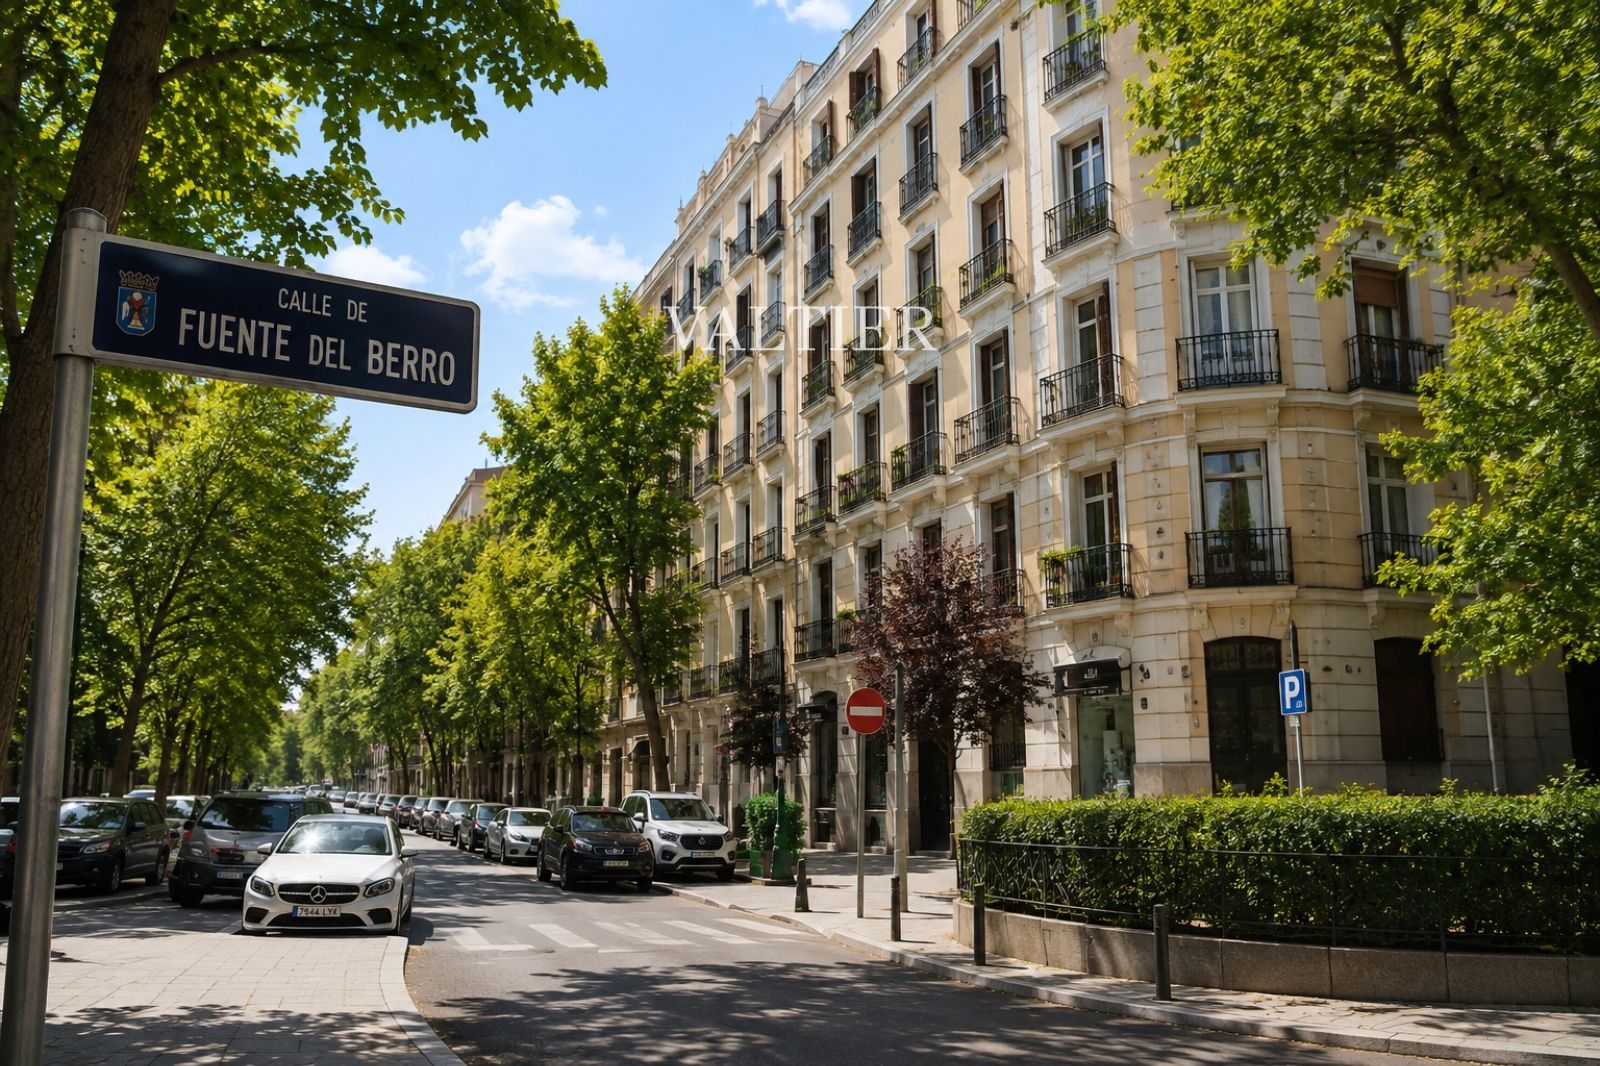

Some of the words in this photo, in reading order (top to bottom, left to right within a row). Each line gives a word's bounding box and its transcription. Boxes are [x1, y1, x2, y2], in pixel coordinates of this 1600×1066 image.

[278, 287, 332, 317] CALLE
[347, 299, 368, 323] DE
[178, 308, 291, 362] FUENTE
[308, 334, 352, 372] DEL
[367, 339, 456, 386] BERRO
[1284, 676, 1300, 709] P
